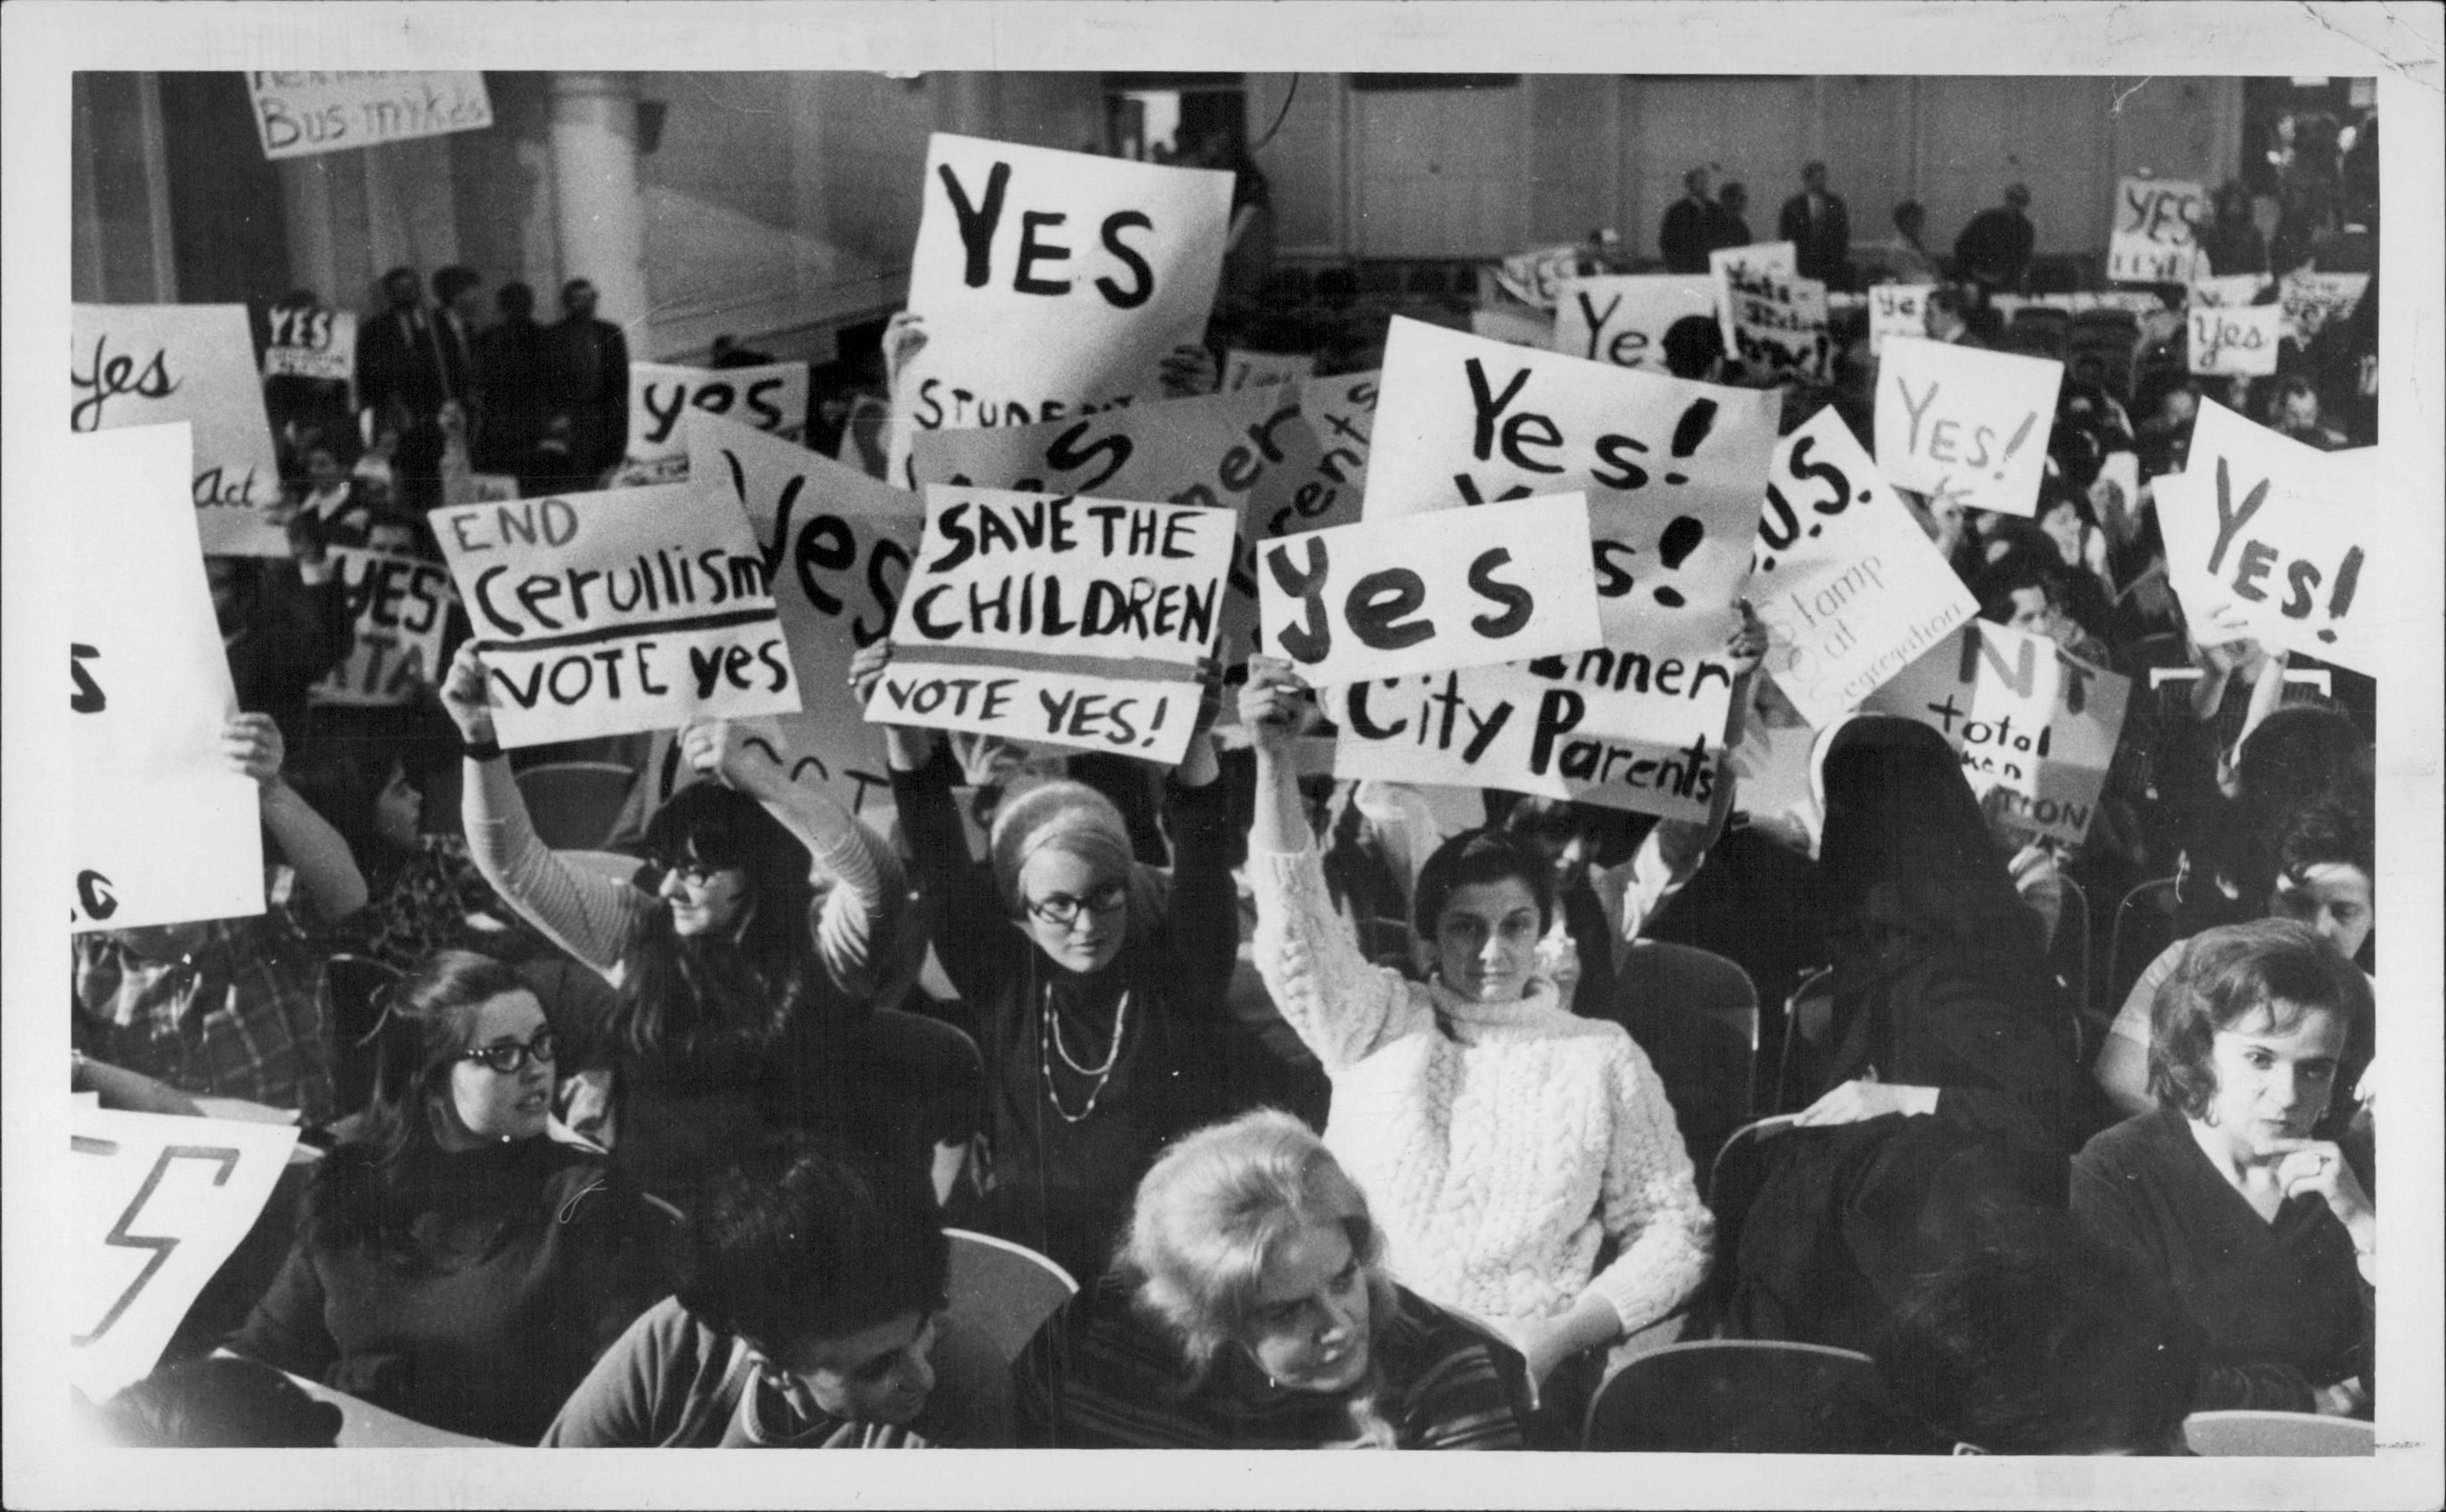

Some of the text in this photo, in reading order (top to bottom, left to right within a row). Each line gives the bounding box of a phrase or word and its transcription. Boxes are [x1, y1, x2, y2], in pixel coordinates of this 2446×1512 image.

[260, 98, 345, 149] Bus
[938, 161, 1155, 309] YES
[1465, 357, 1718, 490] Yes!
[1897, 376, 2038, 480] YES!
[451, 498, 578, 552] END
[928, 496, 1208, 573] SAVE THE
[2207, 455, 2365, 644] YES!
[476, 546, 772, 636] Cerullism
[913, 572, 1217, 644] CHILDREN
[491, 642, 668, 709] VOTE
[887, 679, 1168, 747] VOTE YES!
[1347, 669, 1715, 804] City Parents
[1927, 694, 2052, 759] total
